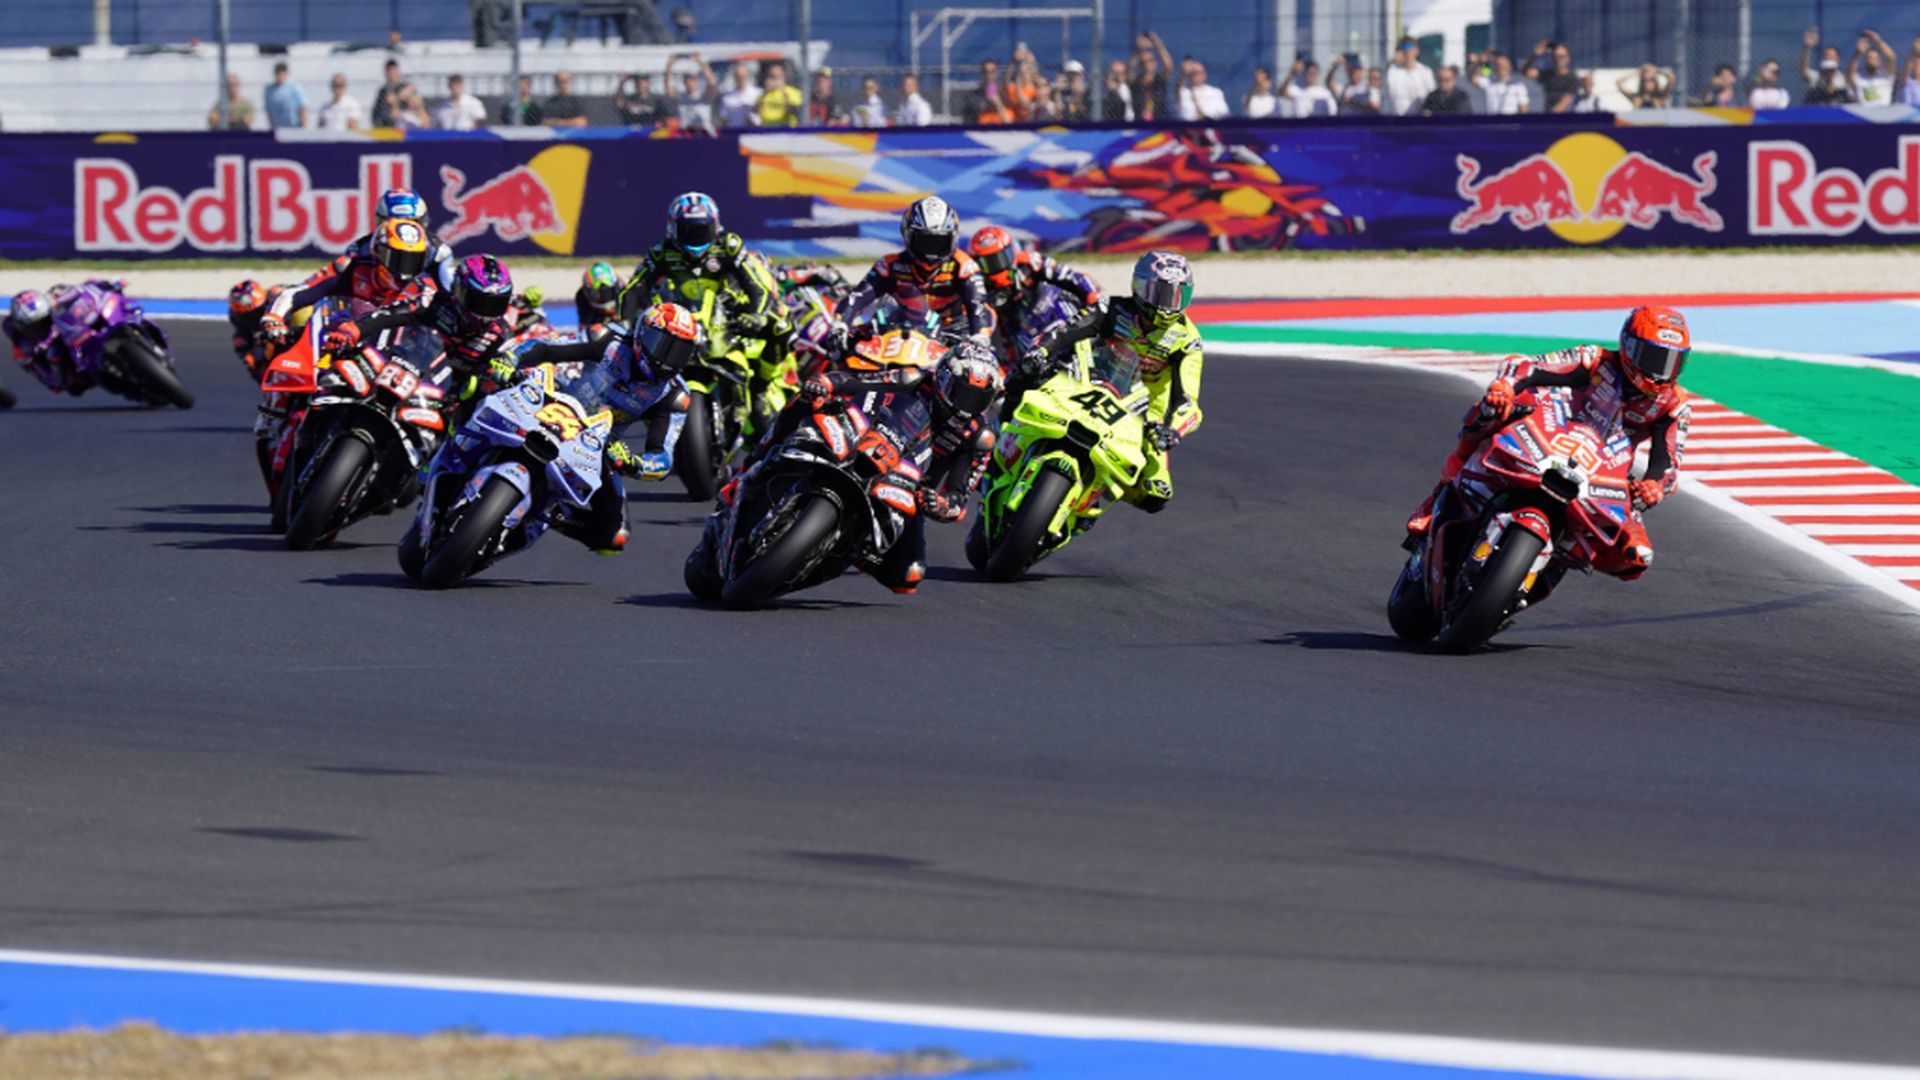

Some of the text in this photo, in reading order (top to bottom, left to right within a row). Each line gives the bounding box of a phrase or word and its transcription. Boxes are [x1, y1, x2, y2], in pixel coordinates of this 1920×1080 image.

[75, 156, 246, 252] Red
[1748, 135, 1920, 236] Red
[883, 335, 923, 360] 37
[534, 402, 583, 442] 54
[1069, 390, 1127, 426] 49
[1515, 423, 1545, 460] Lenovo
[1550, 432, 1603, 475] 93
[1589, 485, 1627, 499] Lenovo
